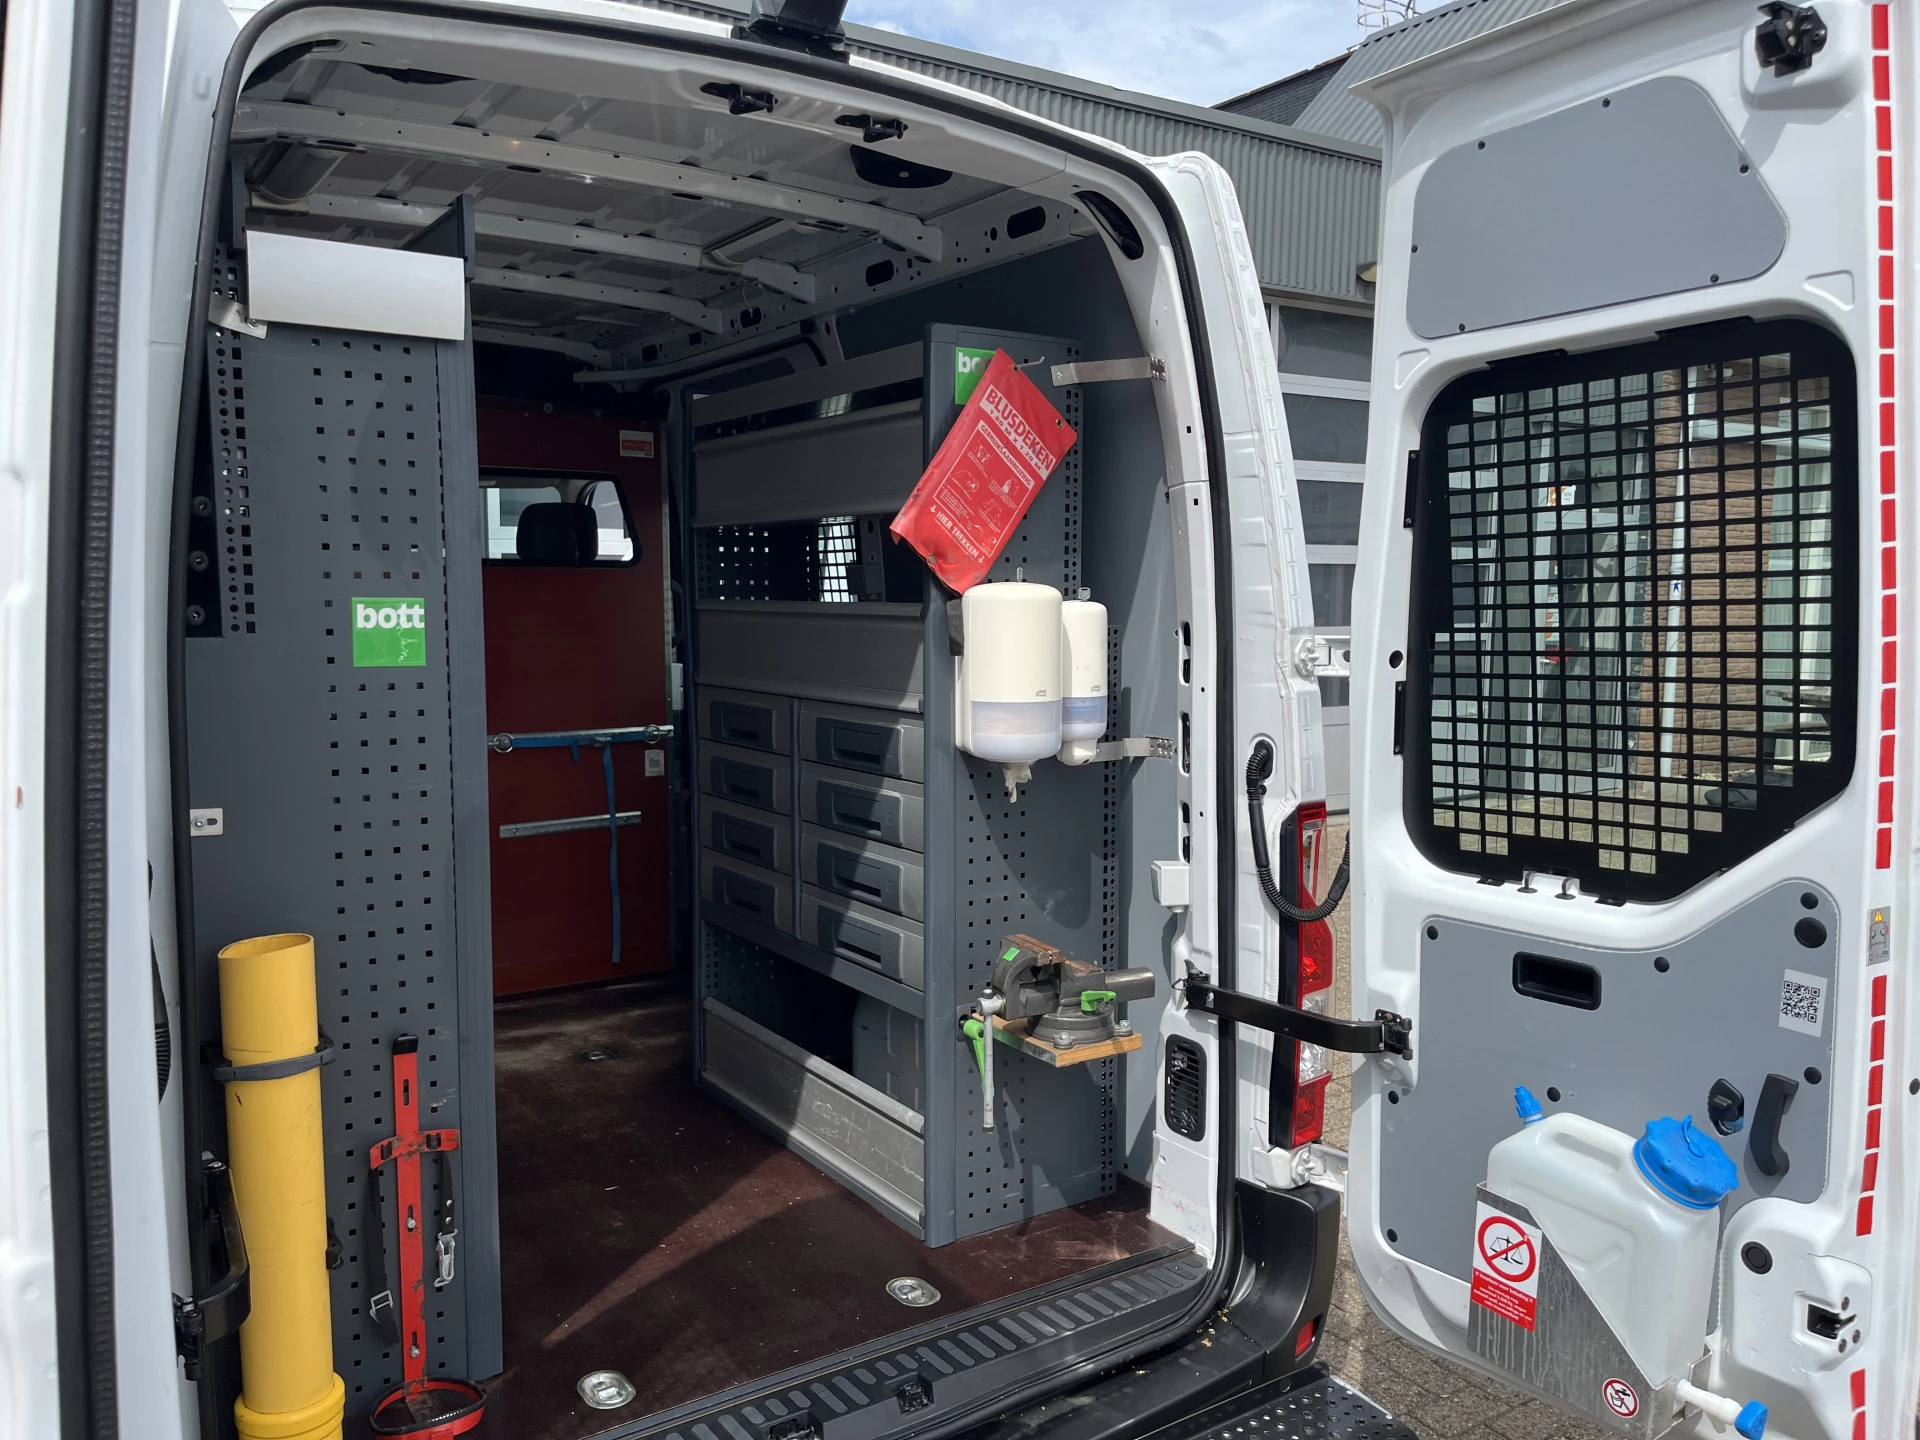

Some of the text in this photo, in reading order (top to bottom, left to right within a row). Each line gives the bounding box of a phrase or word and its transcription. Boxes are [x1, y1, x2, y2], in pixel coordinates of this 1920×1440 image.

[986, 388, 1053, 471] BLUSDEKEN
[1004, 428, 1011, 437] M
[1034, 462, 1041, 471] M
[936, 511, 953, 530] HIER
[951, 526, 979, 558] TREKKEN
[356, 602, 425, 629] bott
